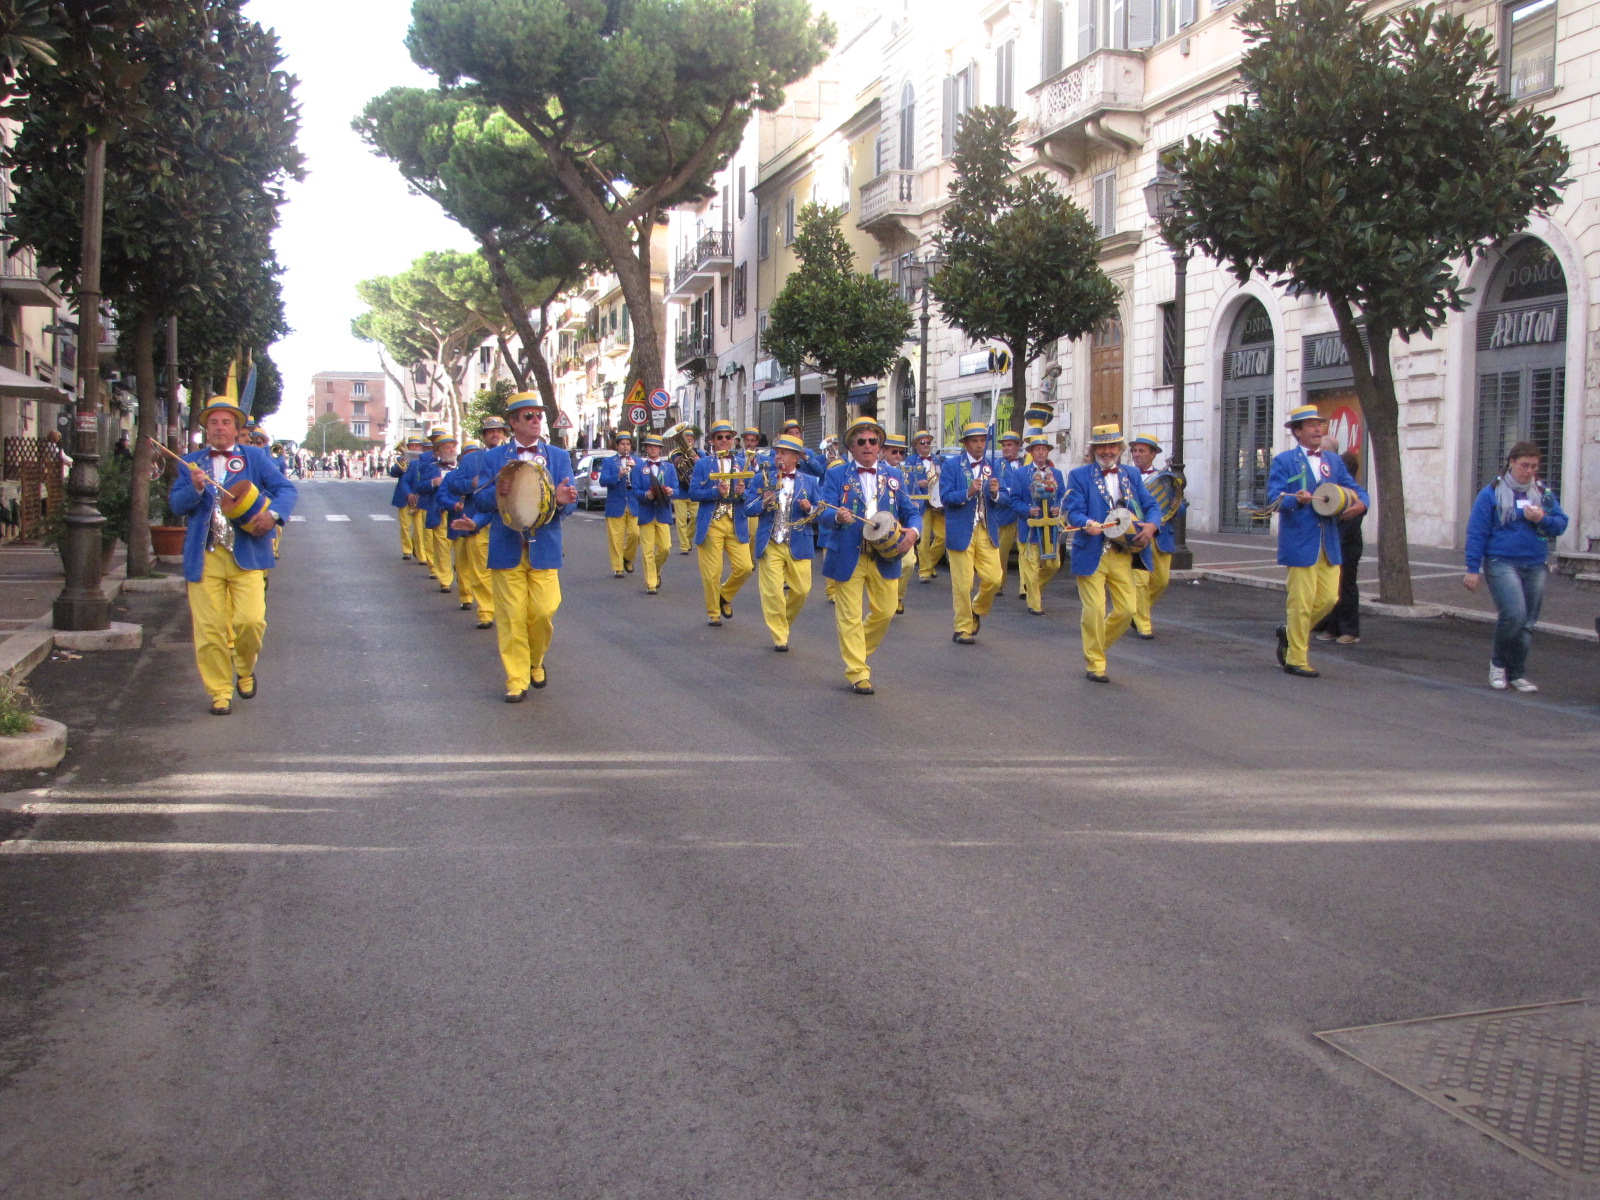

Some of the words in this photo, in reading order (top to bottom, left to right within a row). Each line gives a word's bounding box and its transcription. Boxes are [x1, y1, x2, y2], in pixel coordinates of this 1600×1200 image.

[1519, 74, 1543, 89] UOMO
[1489, 307, 1558, 350] ARISTON
[1230, 348, 1271, 380] ARISTON
[633, 410, 645, 420] 30
